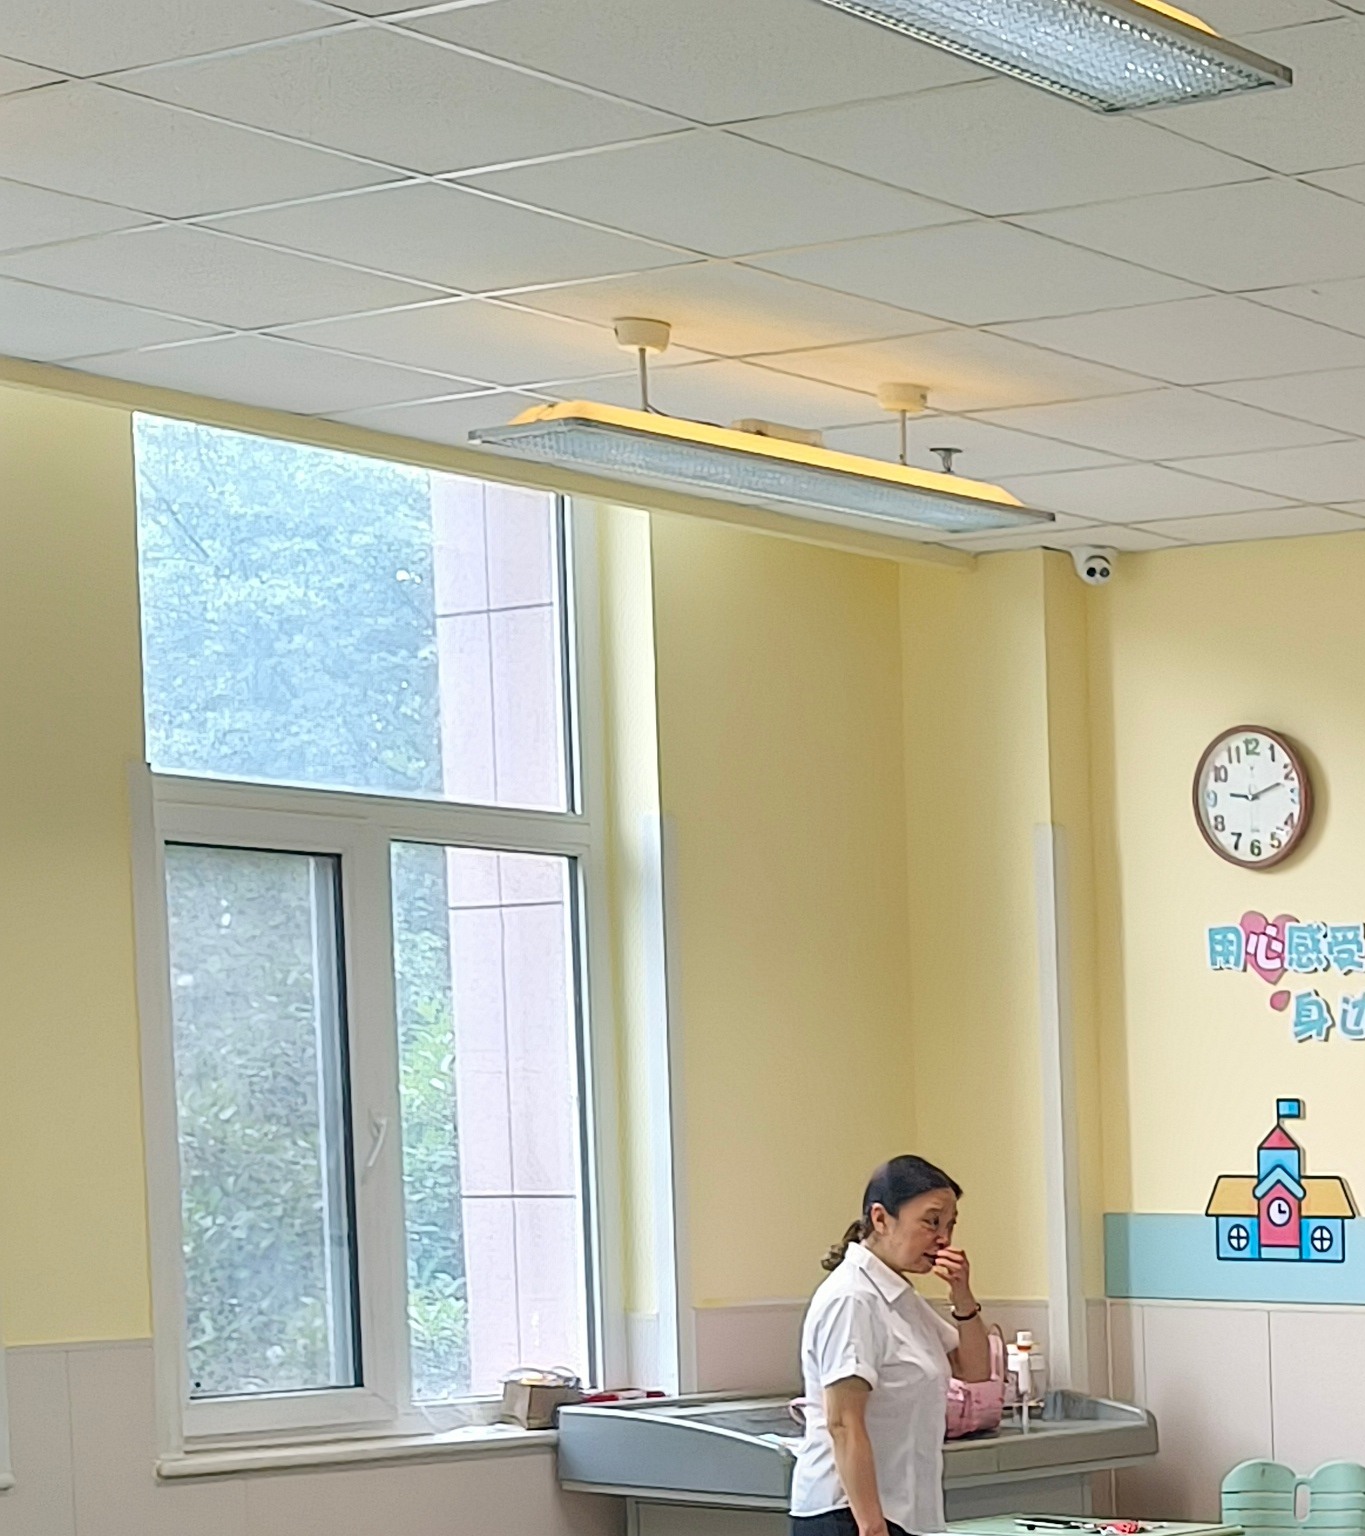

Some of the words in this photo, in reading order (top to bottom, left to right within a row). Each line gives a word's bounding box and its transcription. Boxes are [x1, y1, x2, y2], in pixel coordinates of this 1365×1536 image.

[1228, 745, 1241, 764] 11
[1243, 738, 1261, 756] 12
[1268, 743, 1276, 762] 1
[1214, 765, 1228, 783] 10
[1283, 763, 1295, 781] 2
[1206, 790, 1217, 808] 9
[1214, 814, 1225, 832] 8
[1231, 832, 1242, 851] 7
[1250, 839, 1262, 857] 6
[1270, 832, 1282, 849] 5
